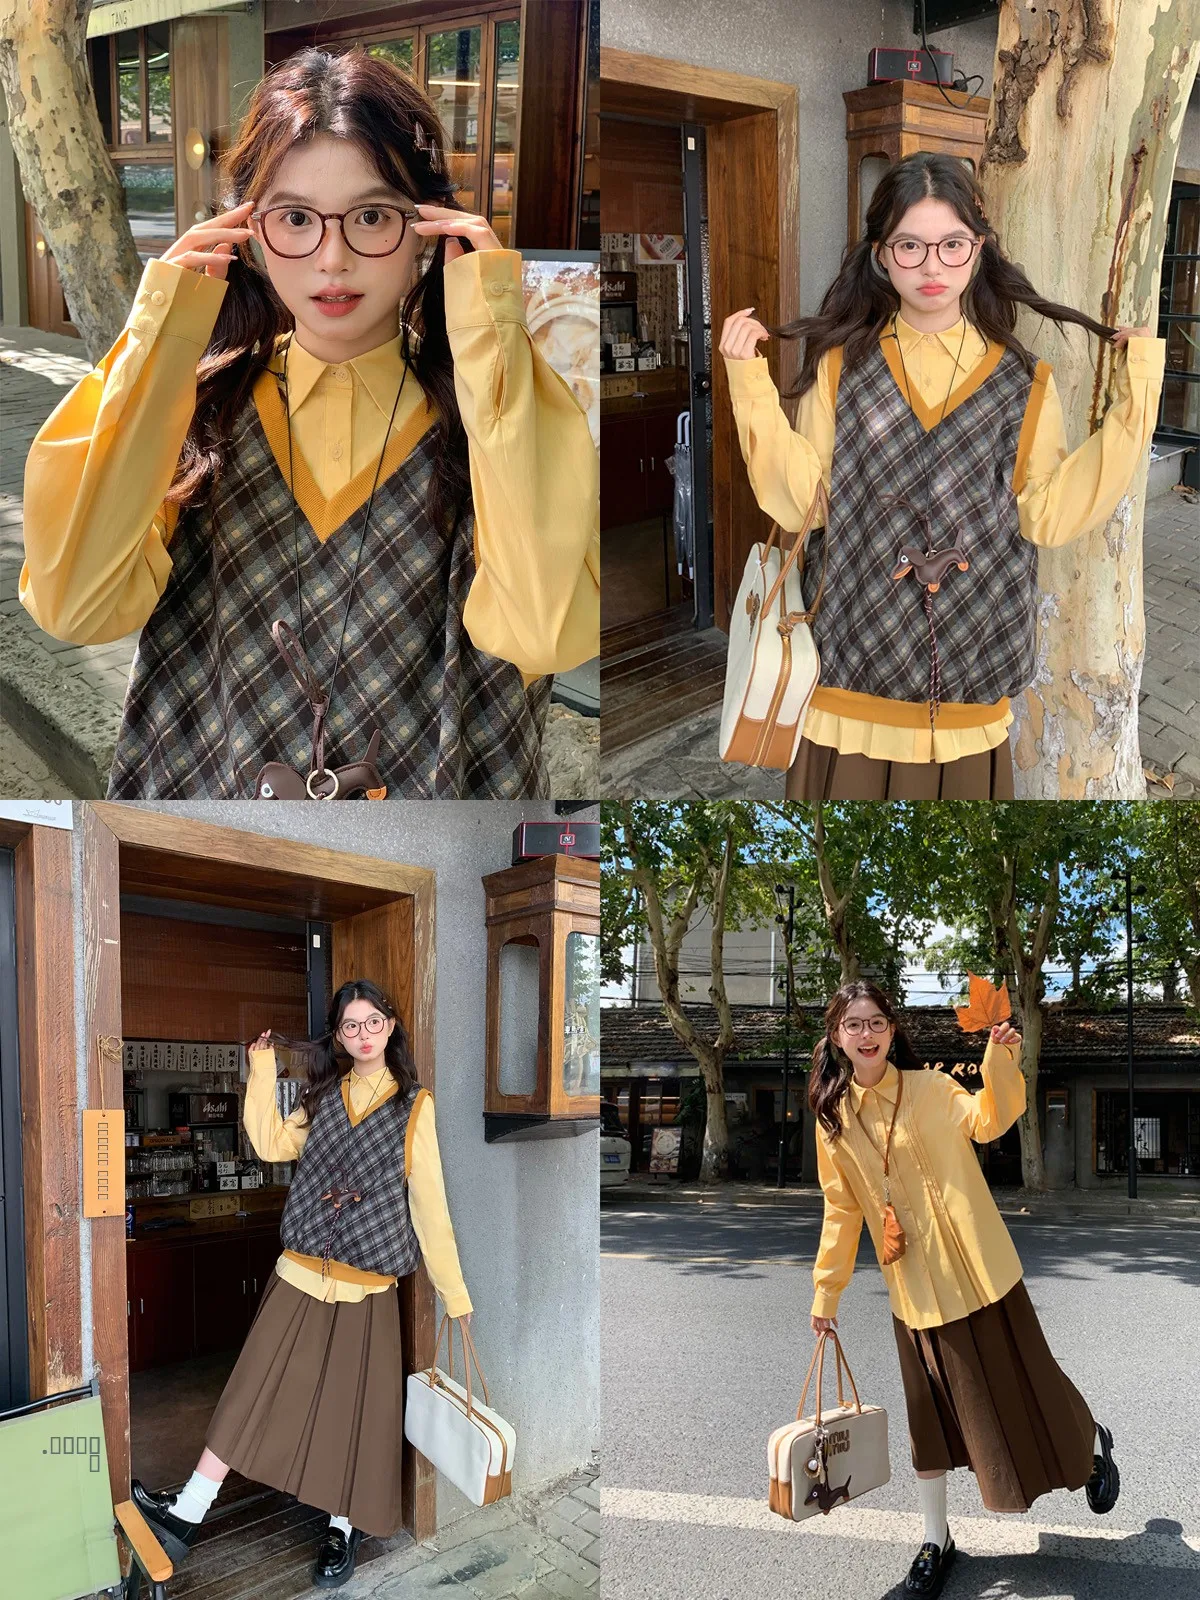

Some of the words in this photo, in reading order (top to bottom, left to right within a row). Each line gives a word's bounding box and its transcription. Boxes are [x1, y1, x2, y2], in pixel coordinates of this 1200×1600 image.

[600, 280, 626, 292] Asahi
[951, 1062, 983, 1077] RO
[203, 1101, 228, 1113] Asahi
[829, 1429, 850, 1444] miu
